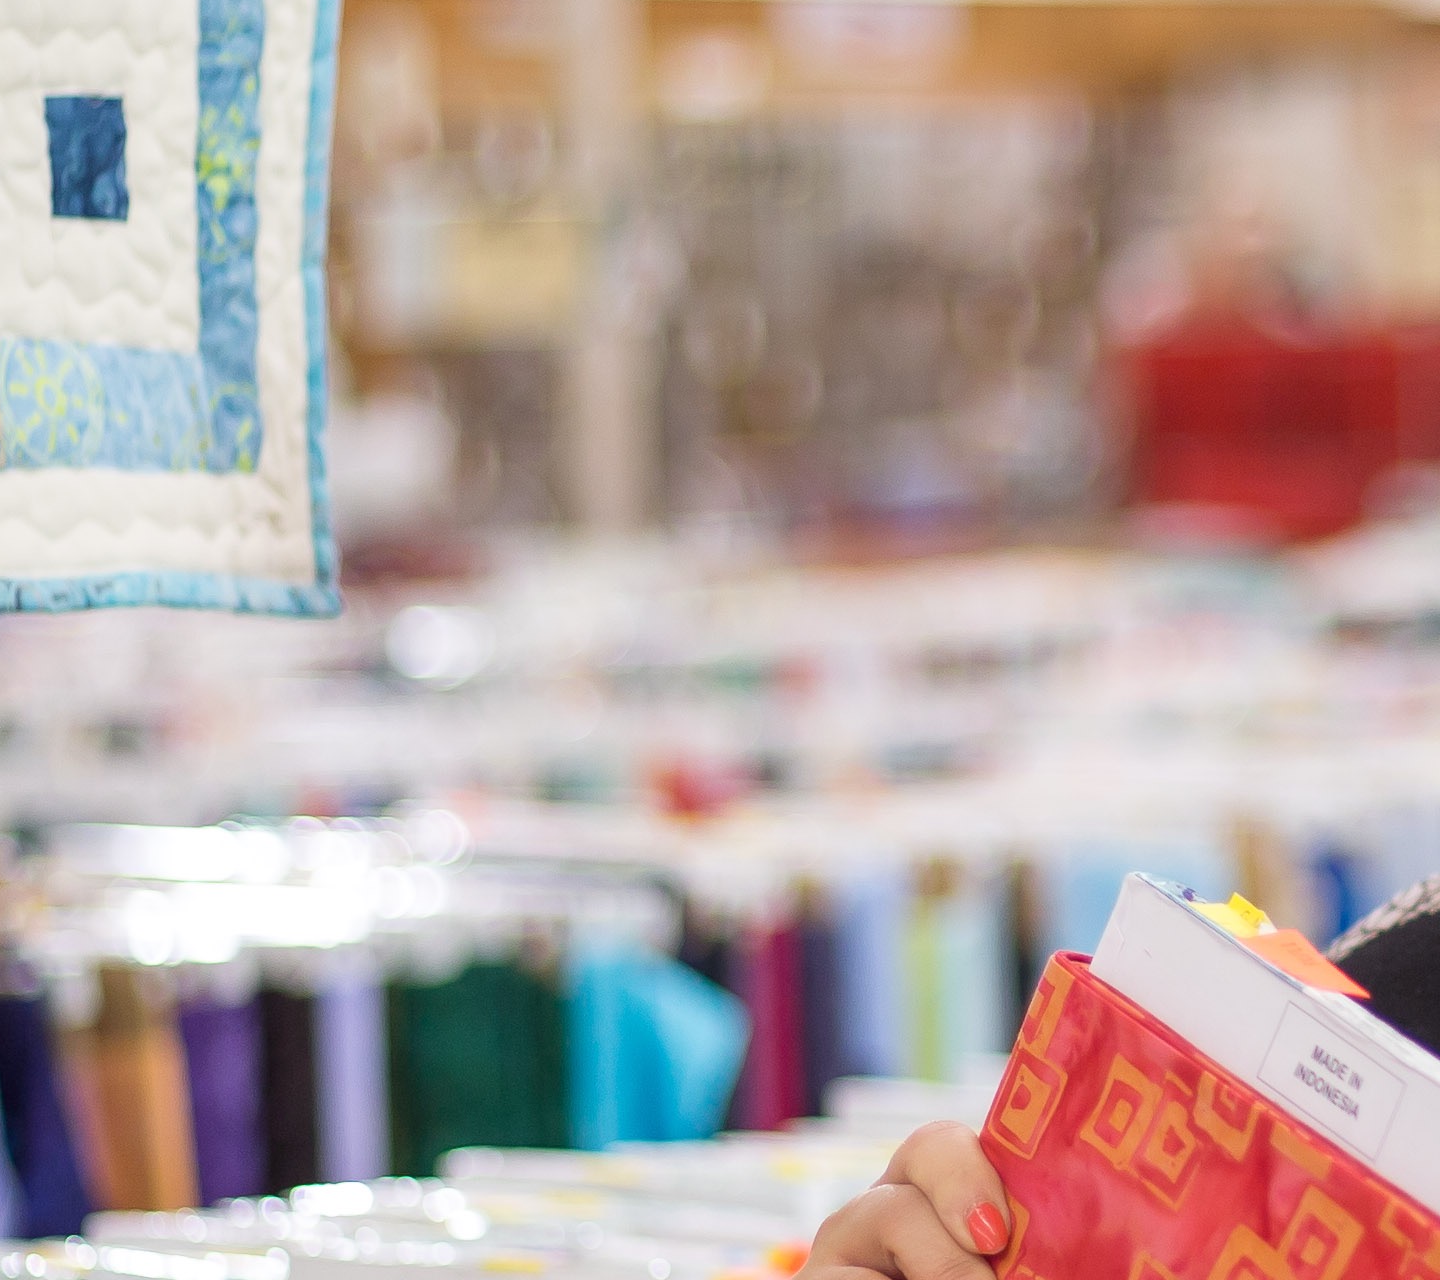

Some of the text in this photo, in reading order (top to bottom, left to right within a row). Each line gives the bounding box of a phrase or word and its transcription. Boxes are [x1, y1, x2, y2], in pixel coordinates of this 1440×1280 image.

[1294, 1062, 1359, 1120] INDONESIA
[1311, 1045, 1363, 1090] MADE IN
